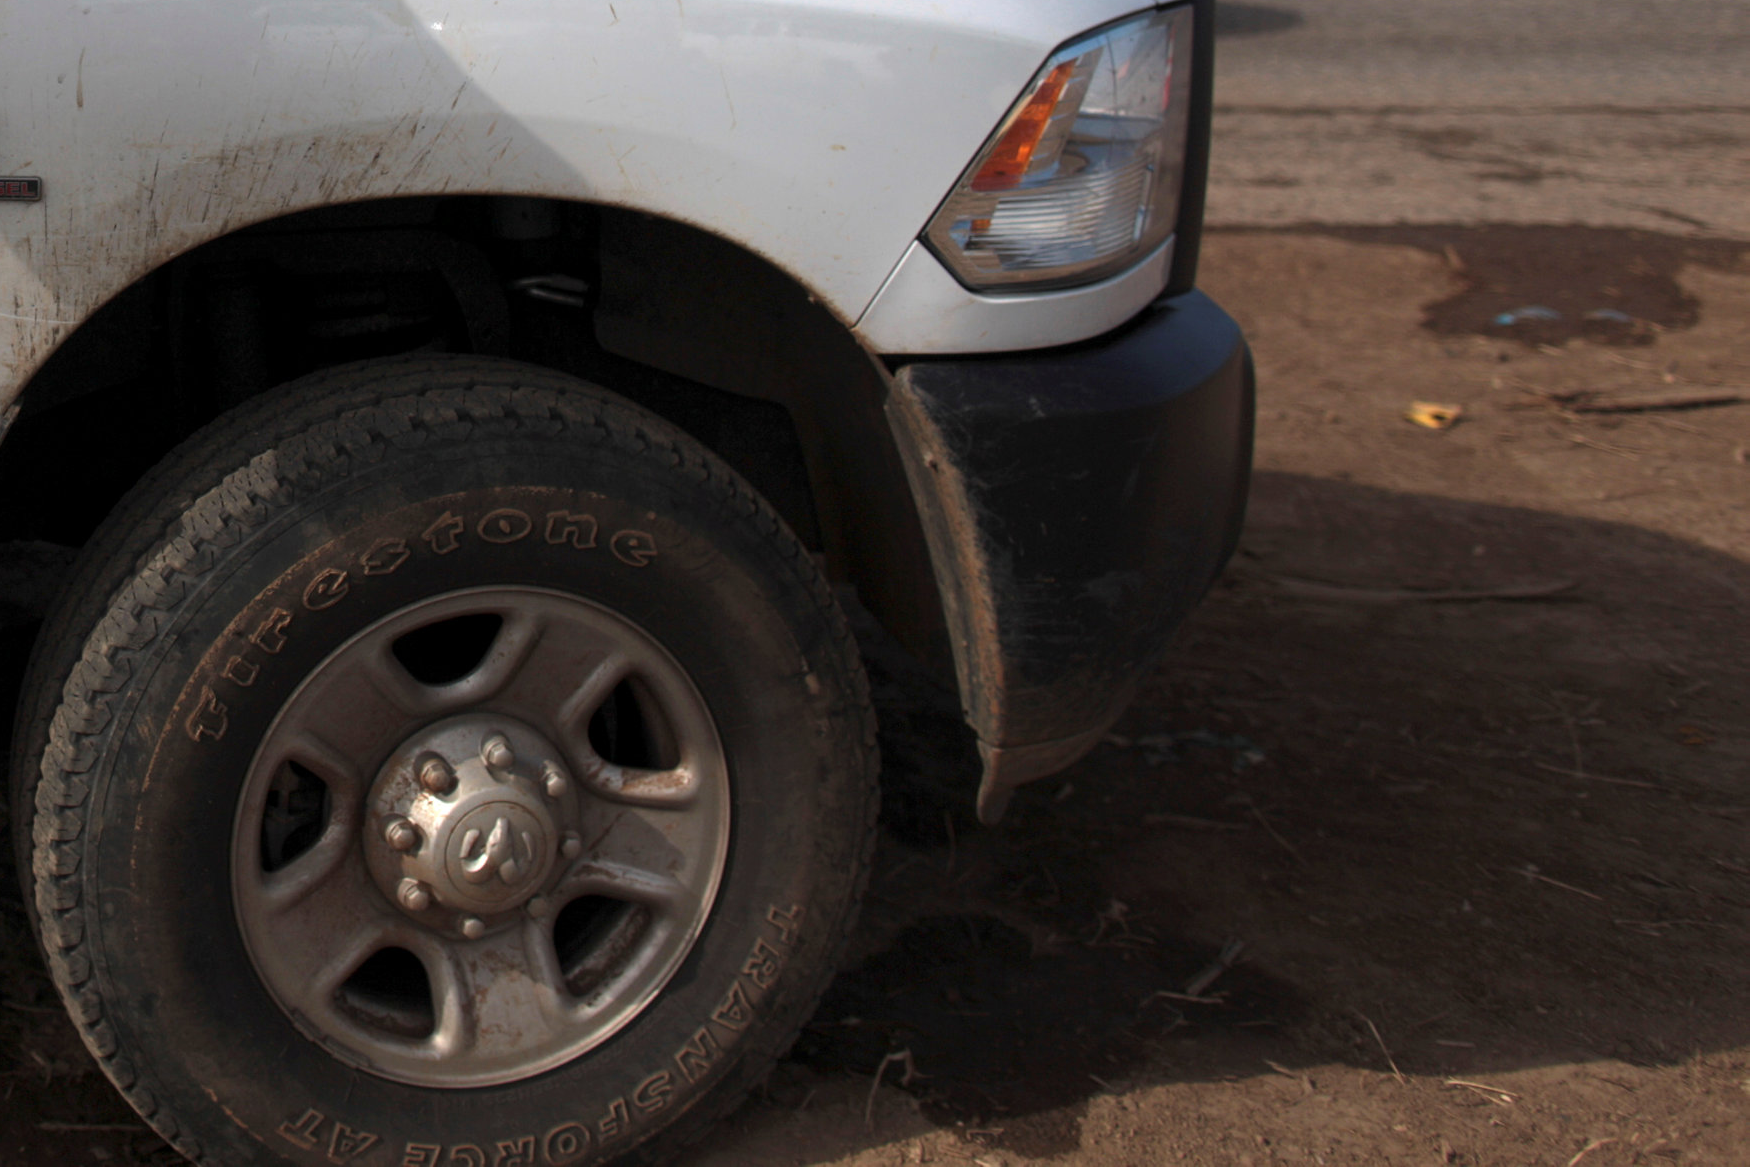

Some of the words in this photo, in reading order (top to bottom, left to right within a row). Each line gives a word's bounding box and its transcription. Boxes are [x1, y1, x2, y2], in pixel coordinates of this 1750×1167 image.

[184, 508, 658, 742] Firestone
[276, 1105, 380, 1165] AT
[402, 903, 806, 1167] TRANSFORCE
